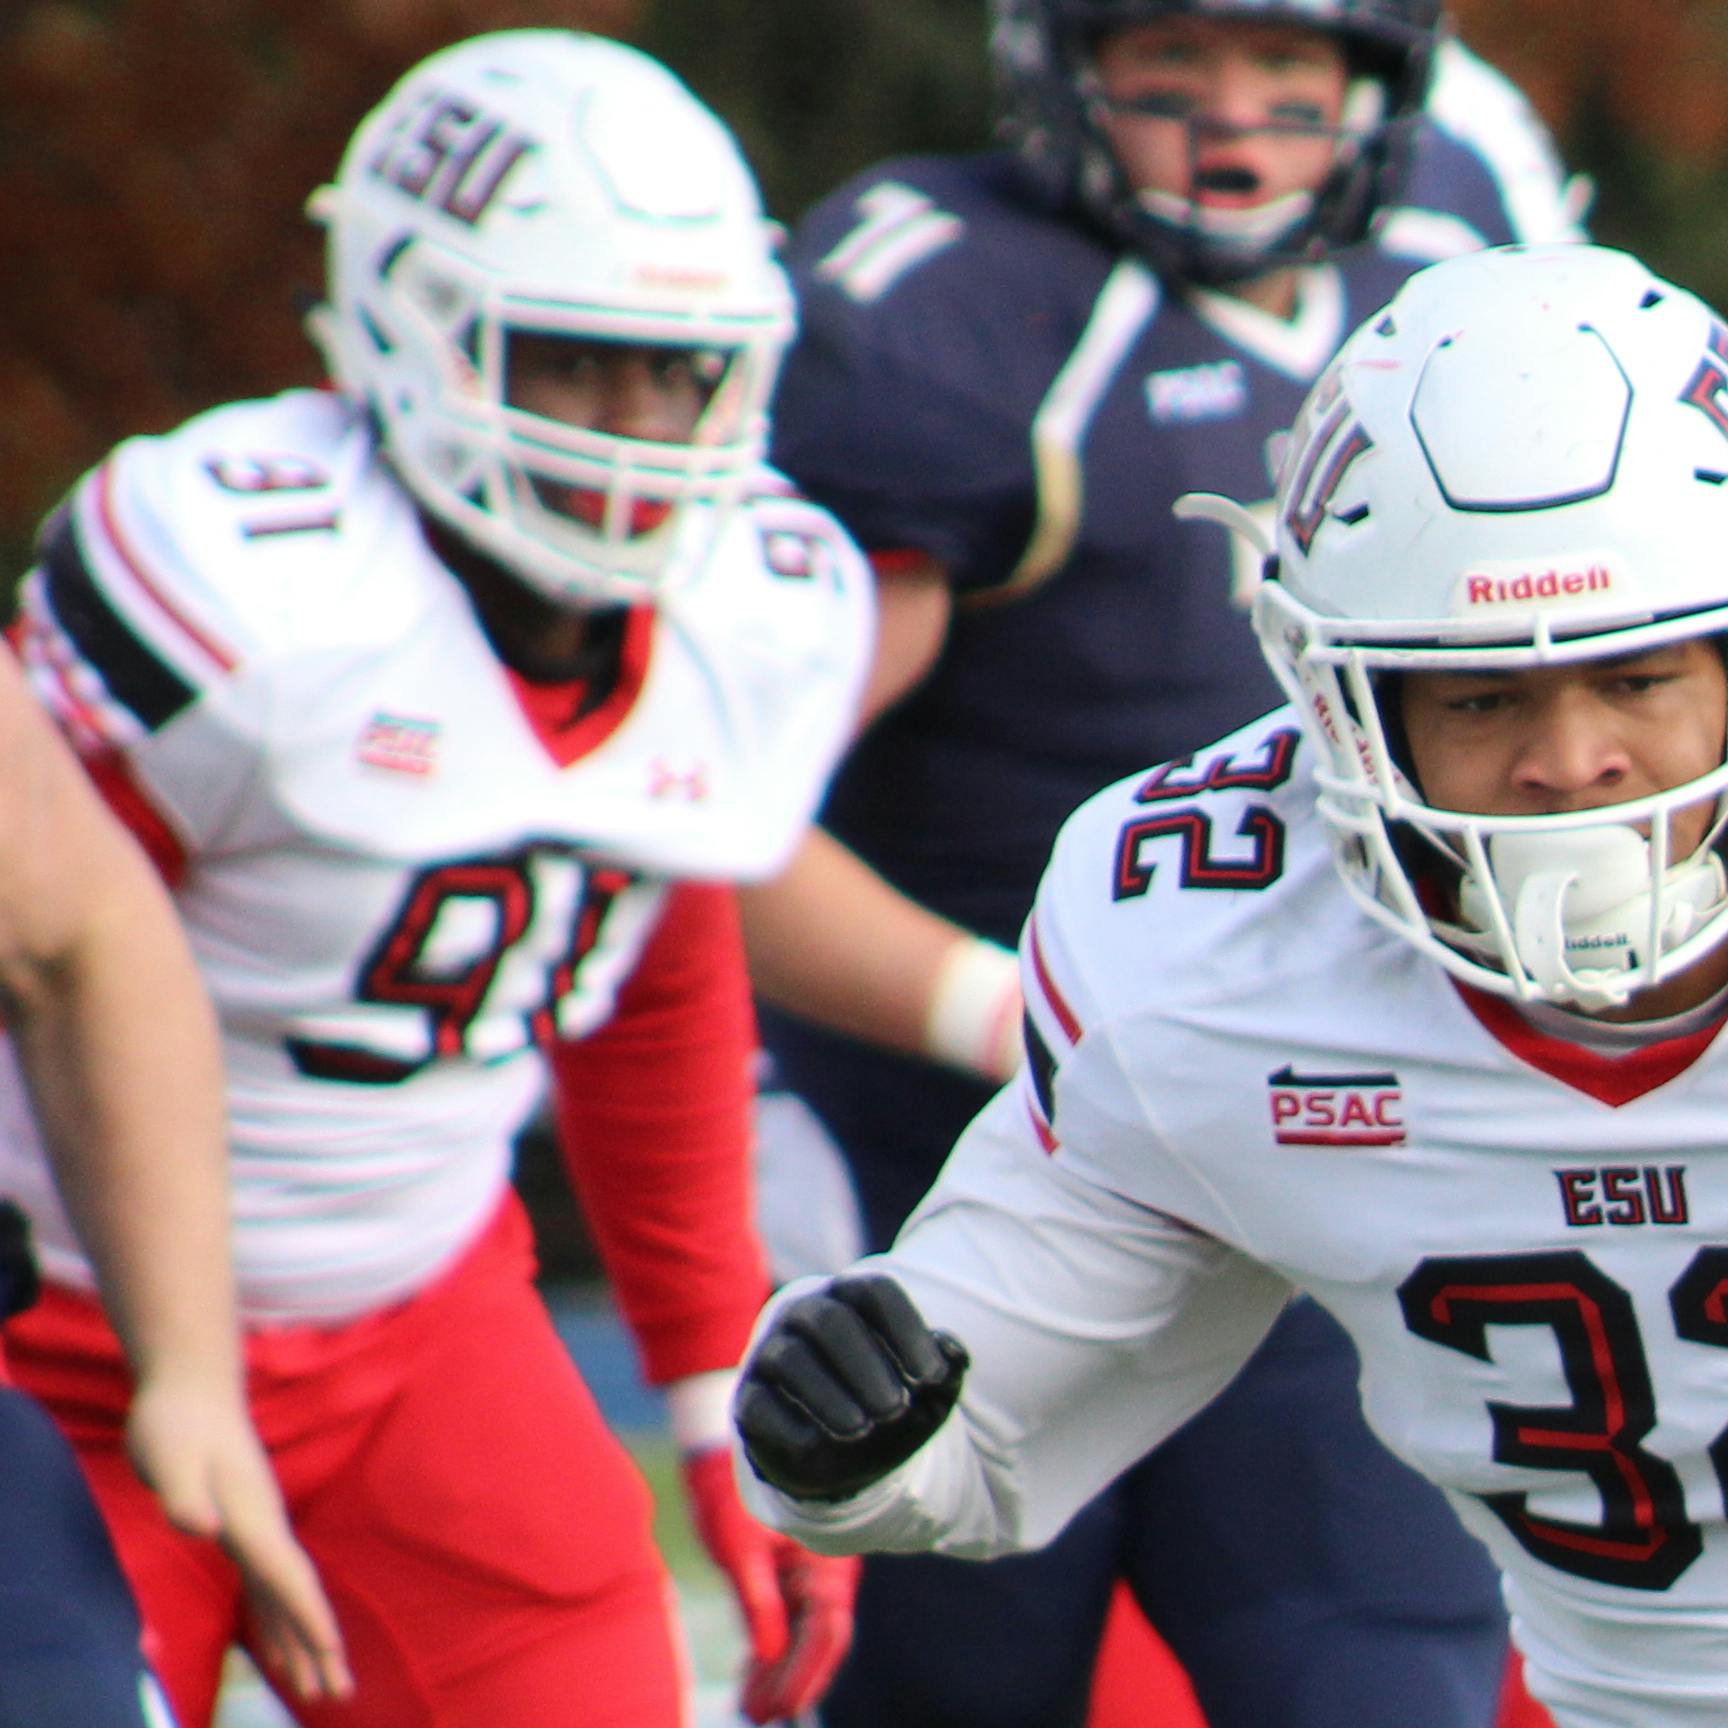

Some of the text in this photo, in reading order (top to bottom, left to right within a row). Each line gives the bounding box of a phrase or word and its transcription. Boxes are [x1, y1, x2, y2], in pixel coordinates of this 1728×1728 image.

[1467, 563, 1610, 604] Riddell
[1113, 727, 1303, 903] 32
[284, 833, 644, 1085] 91
[1269, 1091, 1404, 1128] PSAC
[1552, 1165, 1690, 1227] ESU
